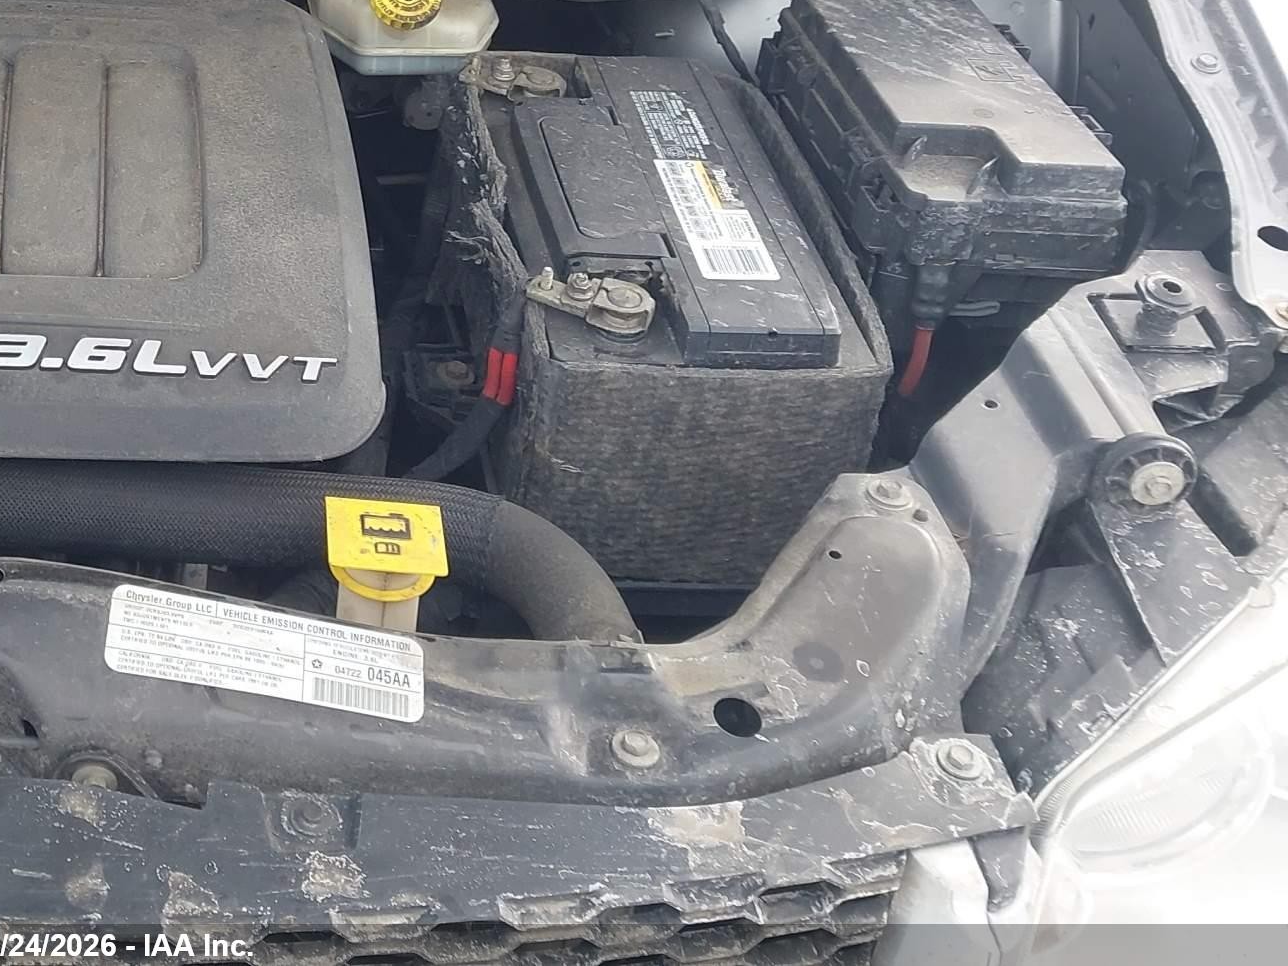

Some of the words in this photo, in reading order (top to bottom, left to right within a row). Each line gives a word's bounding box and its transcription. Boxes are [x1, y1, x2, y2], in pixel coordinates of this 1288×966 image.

[191, 350, 338, 382] VVT
[126, 590, 163, 605] Chrysler
[165, 598, 192, 611] Group
[196, 603, 212, 614] LLC
[223, 608, 259, 623] VEHICLE
[262, 616, 304, 631] EMISSION
[307, 624, 348, 639] CONTROL
[350, 633, 411, 651] INFORMATION
[334, 665, 362, 678] 04722
[367, 667, 411, 688] 045AA
